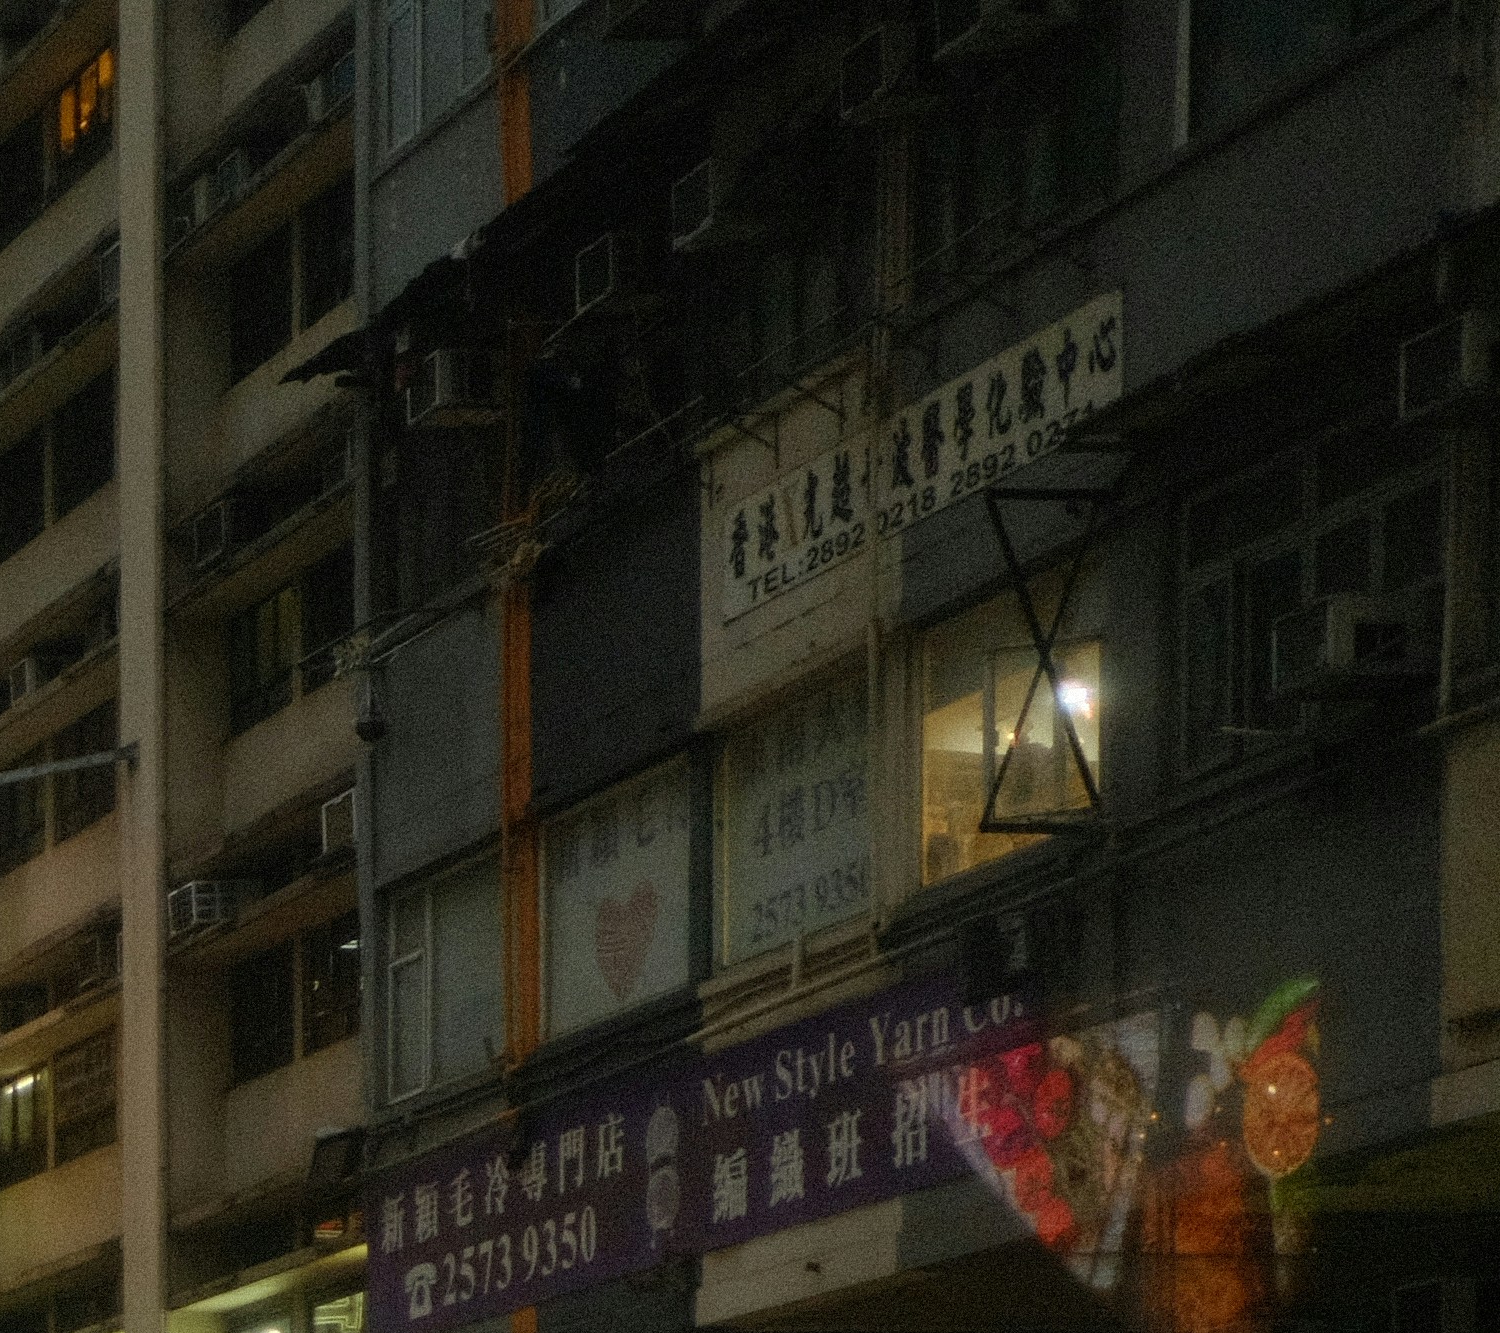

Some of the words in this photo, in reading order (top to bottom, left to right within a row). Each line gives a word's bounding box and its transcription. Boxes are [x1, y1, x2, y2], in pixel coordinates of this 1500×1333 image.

[748, 522, 866, 602] TEL:2892
[951, 444, 1017, 497] 2892
[700, 1073, 765, 1128] New
[773, 1032, 856, 1103] Style
[869, 1002, 952, 1068] Yarn
[442, 1235, 513, 1307] 2573
[523, 1204, 599, 1294] 9350
